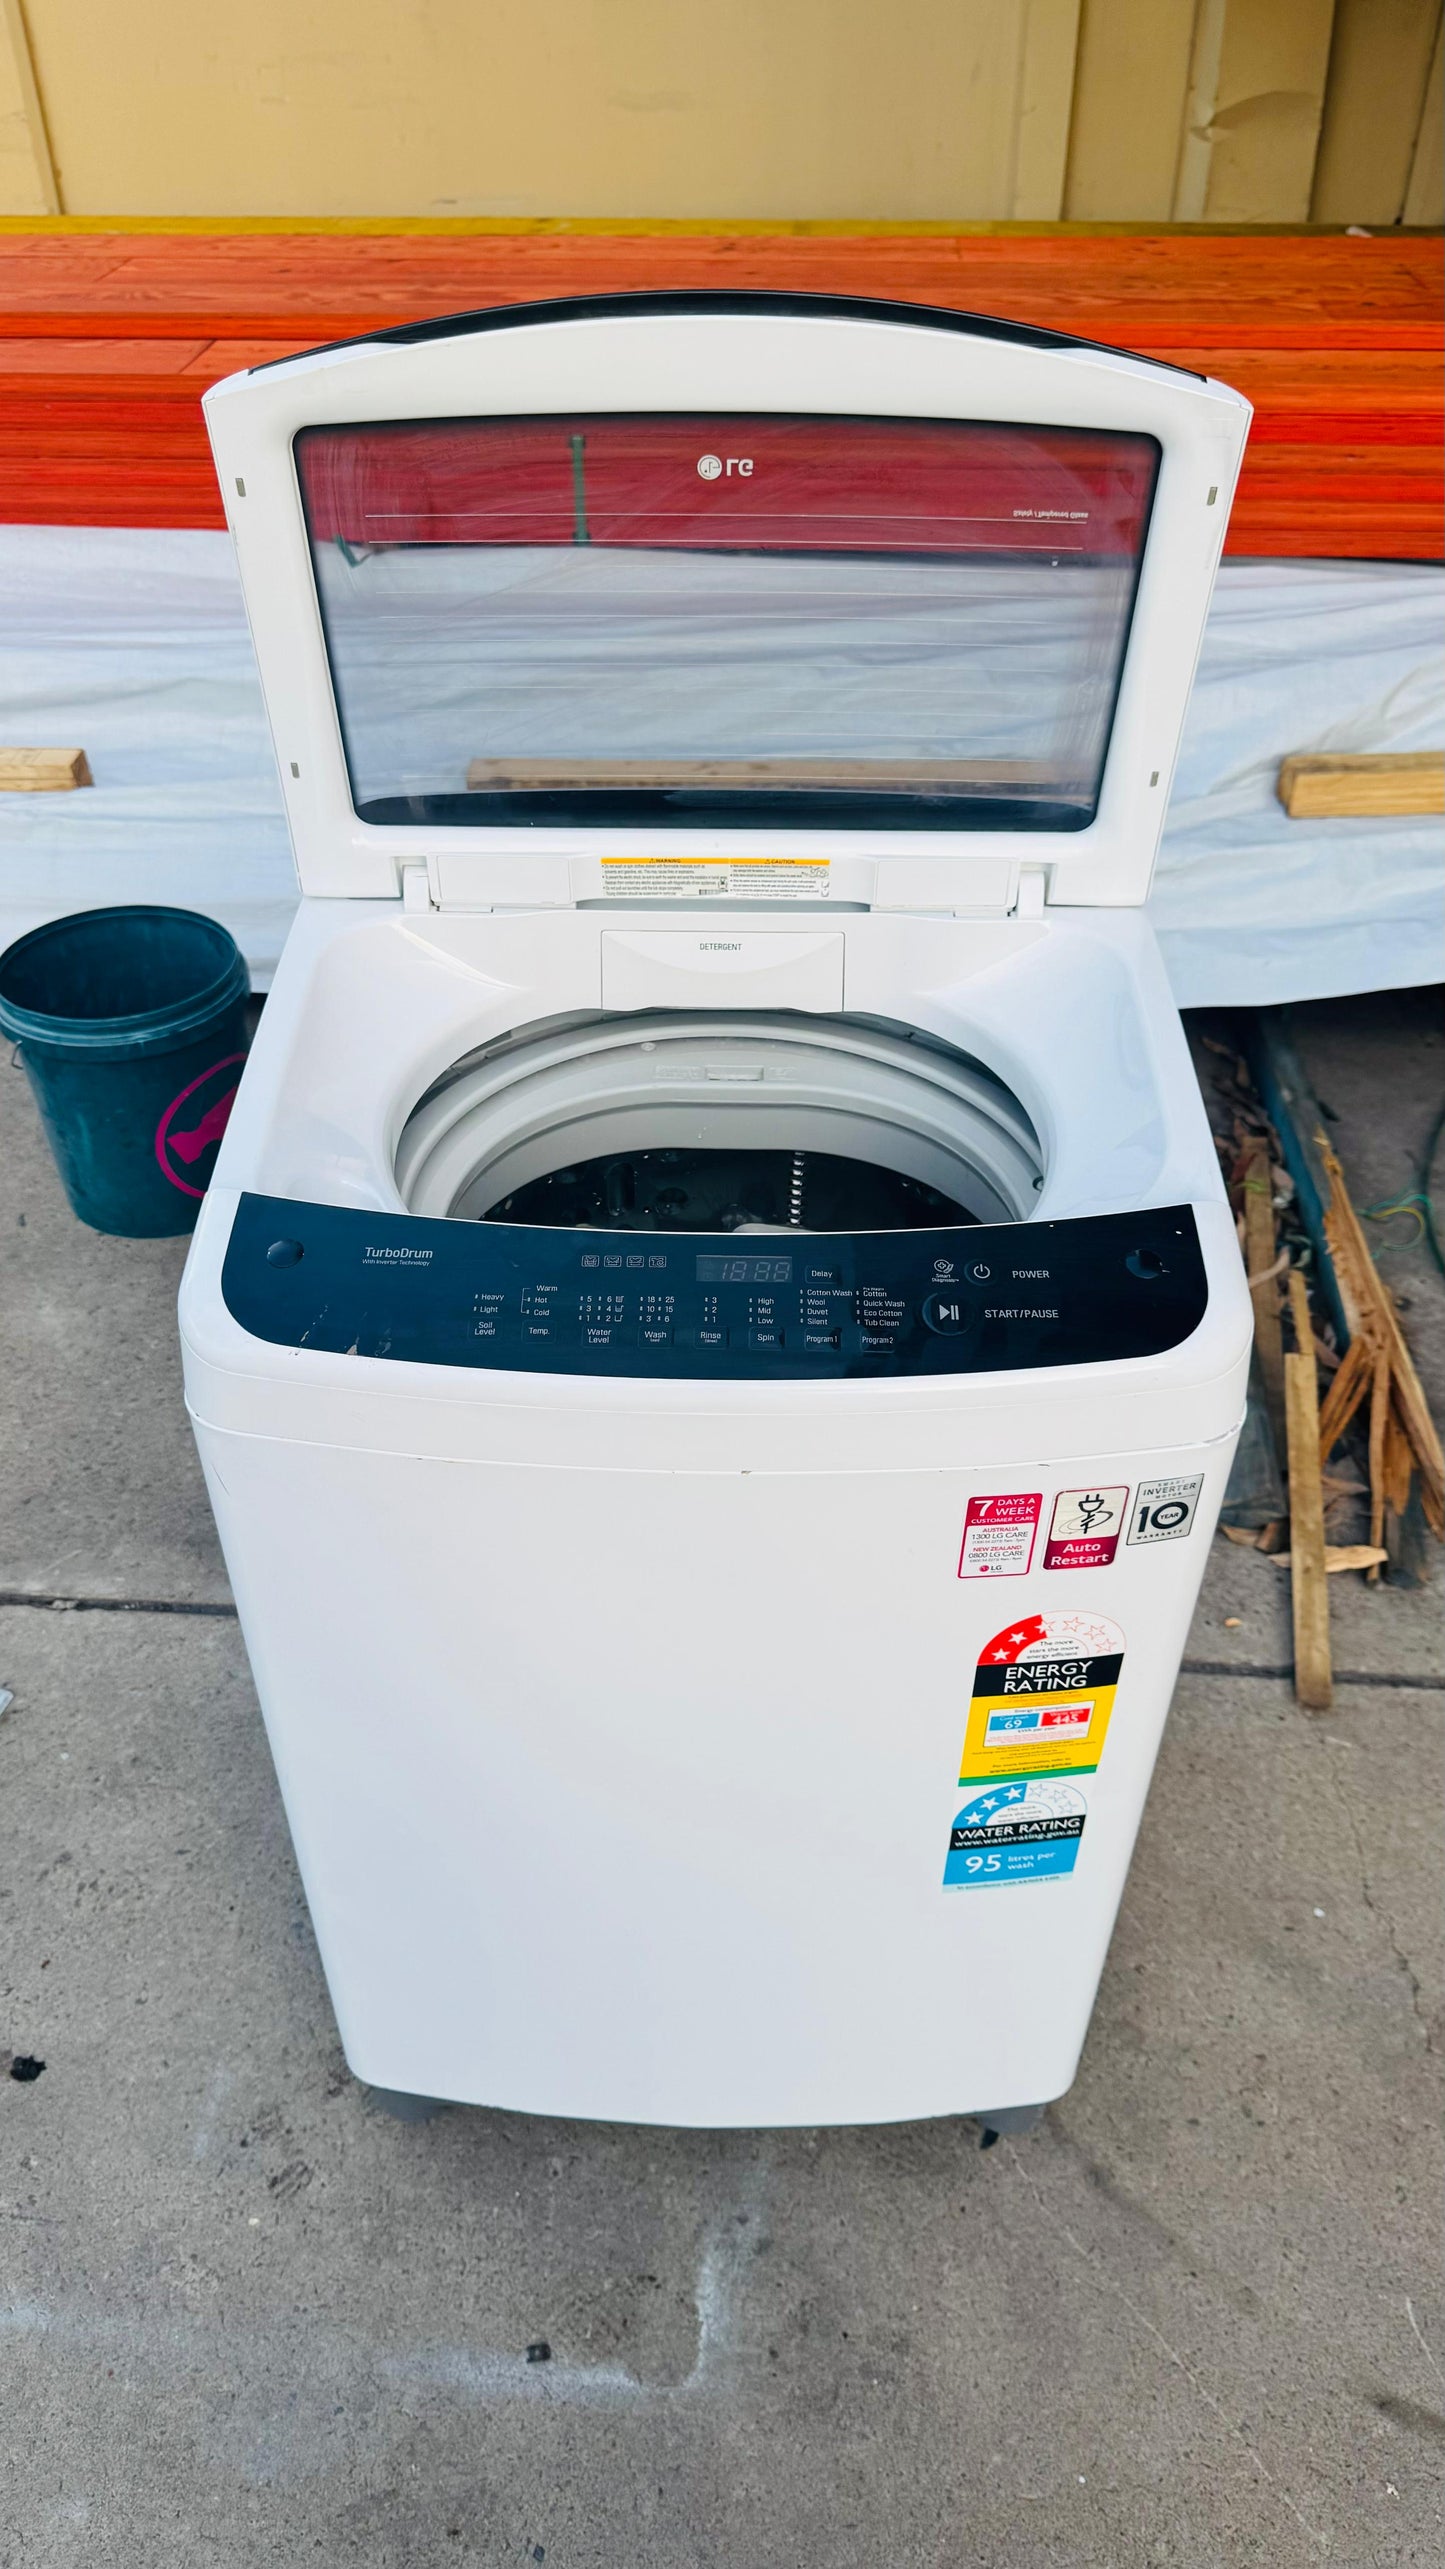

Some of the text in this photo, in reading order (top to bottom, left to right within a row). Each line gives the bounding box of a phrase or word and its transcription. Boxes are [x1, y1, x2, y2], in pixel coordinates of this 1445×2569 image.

[365, 1247, 433, 1258] TurboDrum
[812, 1270, 832, 1278] Delay
[1012, 1270, 1049, 1279] POWER
[480, 1306, 498, 1314] Light
[985, 1309, 1059, 1318] START/PAUSE
[529, 1328, 549, 1336] Temp.
[807, 1335, 833, 1343] Program
[1143, 1482, 1196, 1496] INVERTER
[974, 1500, 994, 1516] 7
[996, 1506, 1034, 1516] WEEK
[1138, 1502, 1189, 1532] 10
[1137, 1530, 1183, 1540] WARRANTY
[1063, 1544, 1101, 1554] Auto
[1051, 1554, 1109, 1566] Restart
[1006, 1661, 1093, 1679] ENERGY
[1004, 1675, 1088, 1693] RATING
[1052, 1714, 1079, 1724] 445
[1005, 1720, 1022, 1729] 69
[958, 1826, 1014, 1840] WATER
[1019, 1818, 1080, 1833] RATING
[1037, 1852, 1056, 1860] per
[965, 1854, 1002, 1873] 95
[1008, 1861, 1034, 1870] wash
